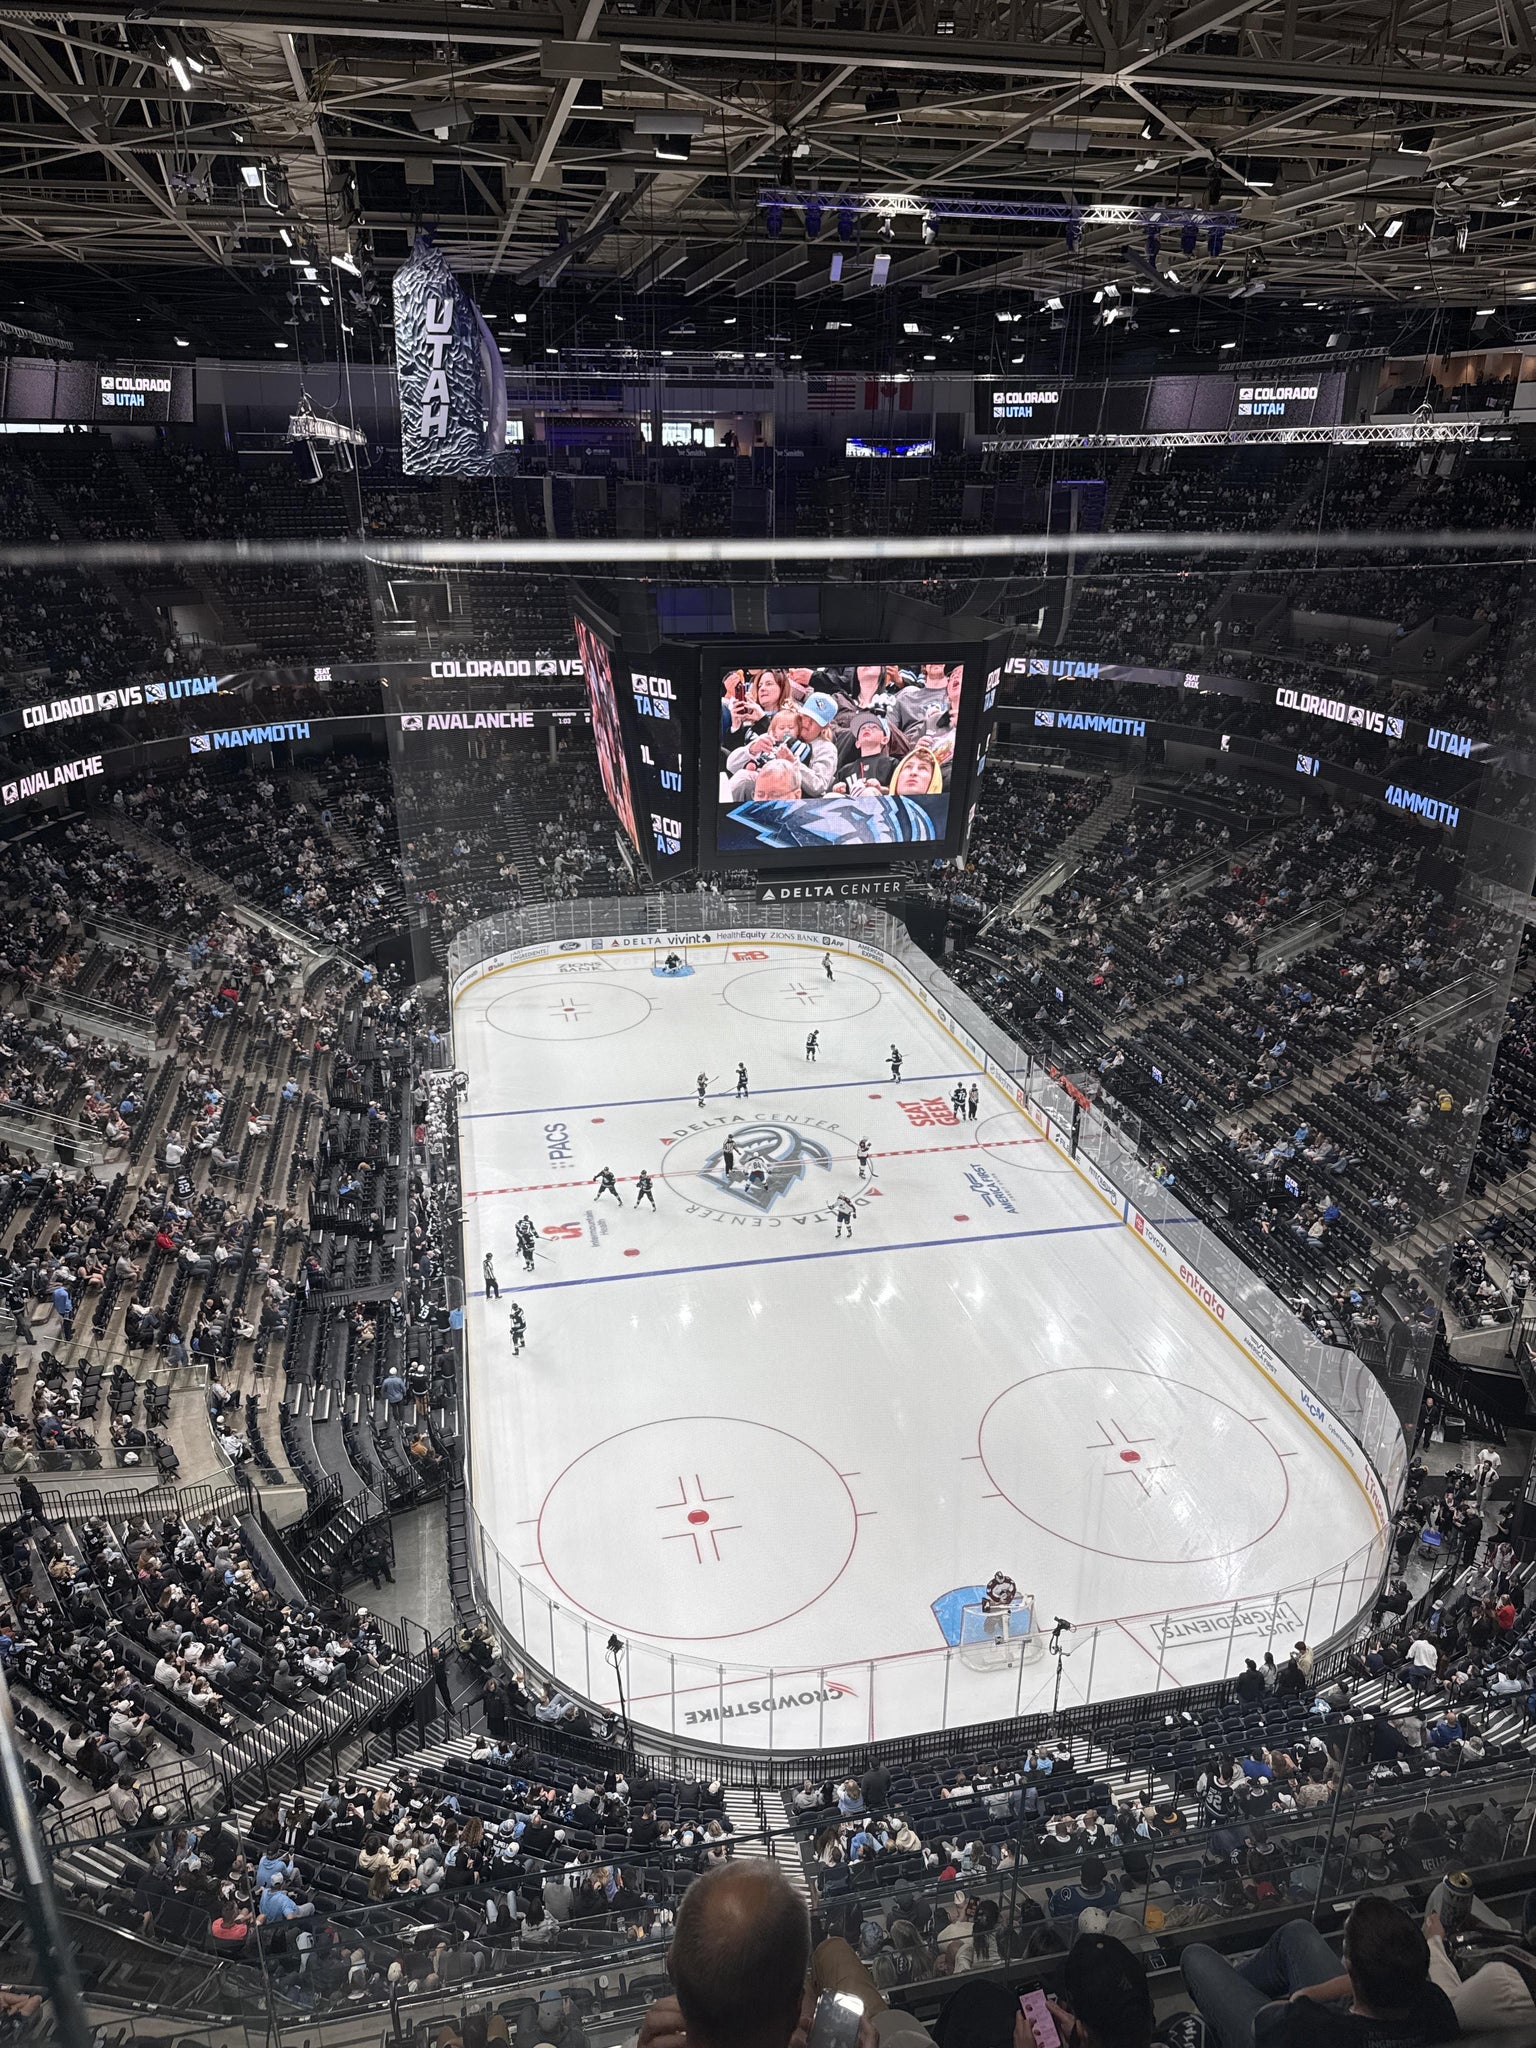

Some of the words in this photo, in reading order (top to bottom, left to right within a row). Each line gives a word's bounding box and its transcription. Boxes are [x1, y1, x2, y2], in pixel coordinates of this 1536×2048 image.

[420, 298, 453, 437] UTAH
[115, 377, 171, 392] COLORADO
[1254, 387, 1318, 400] COLORADO
[116, 393, 144, 406] UTAH
[1005, 392, 1059, 404] COLORADO
[1005, 406, 1033, 417] UTAH
[1253, 403, 1285, 415] UTAH
[314, 667, 330, 675] SEAT
[431, 660, 530, 677] COLORADO
[559, 659, 584, 676] VS
[1052, 660, 1099, 679] UTAH
[314, 674, 332, 682] GEEK
[1184, 681, 1199, 690] GEEK
[1185, 673, 1199, 682] SEAT
[117, 686, 142, 707] VS
[168, 676, 218, 699] UTAH
[427, 712, 534, 730] AVALANCHE
[1057, 712, 1146, 737] MAMMOTH
[1275, 687, 1346, 722] COLORADO
[1365, 711, 1385, 733] VS
[1427, 727, 1472, 759] UTAH
[213, 722, 310, 750] MAMMOTH
[19, 755, 104, 799] AVALANCHE
[1385, 784, 1460, 828] MAMMOTH
[780, 885, 834, 899] DELTA
[840, 881, 900, 895] CENTER
[623, 937, 661, 946] DELTA
[716, 931, 767, 940] HealthEquity
[770, 932, 795, 941] ZIONS
[797, 933, 819, 943] BANK
[512, 949, 547, 961] INGREDIENTS
[857, 943, 884, 957] AMERICAN
[896, 1100, 936, 1127] SEAT
[920, 1096, 961, 1126] GEEK
[673, 1115, 745, 1137] DELTA
[754, 1113, 840, 1131] CENTER
[544, 1123, 573, 1160] PACS
[969, 1163, 993, 1183] FIRST
[987, 1182, 1019, 1214] AMERICA
[685, 1204, 781, 1227] CENTER
[1145, 1227, 1168, 1256] TOYOTA
[1179, 1264, 1225, 1320] entrata
[1161, 1607, 1287, 1639] INGREDIENTS
[1257, 1620, 1299, 1637] JUST
[684, 1688, 844, 1725] CROWDSTRIKE
[1421, 1855, 1447, 1872] KELLE
